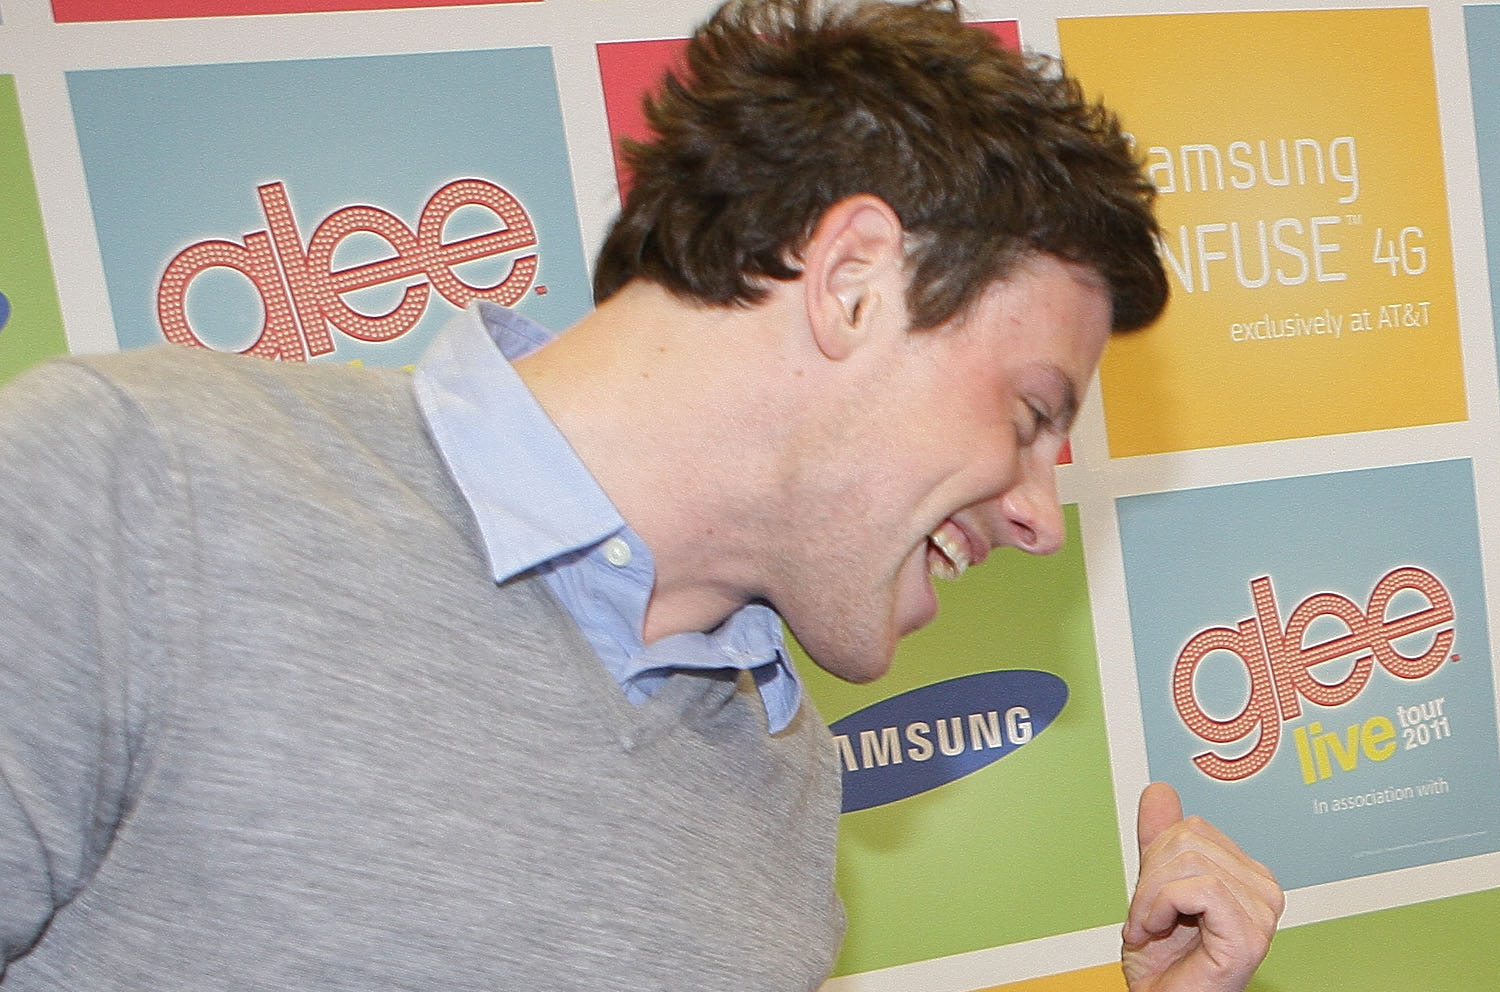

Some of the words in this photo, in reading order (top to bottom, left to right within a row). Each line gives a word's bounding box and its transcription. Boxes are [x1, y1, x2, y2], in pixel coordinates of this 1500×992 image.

[1146, 136, 1361, 204] amsung
[157, 178, 538, 362] glee
[1372, 226, 1428, 277] 4G
[1231, 308, 1344, 342] exclusively
[1350, 308, 1373, 333] at
[1377, 301, 1432, 329] AT&T
[1173, 566, 1455, 781] glee
[832, 705, 1033, 772] AMSUNG
[1396, 697, 1446, 728] tour
[1402, 716, 1452, 751] 2011
[1293, 715, 1397, 785] live
[1331, 786, 1414, 812] association
